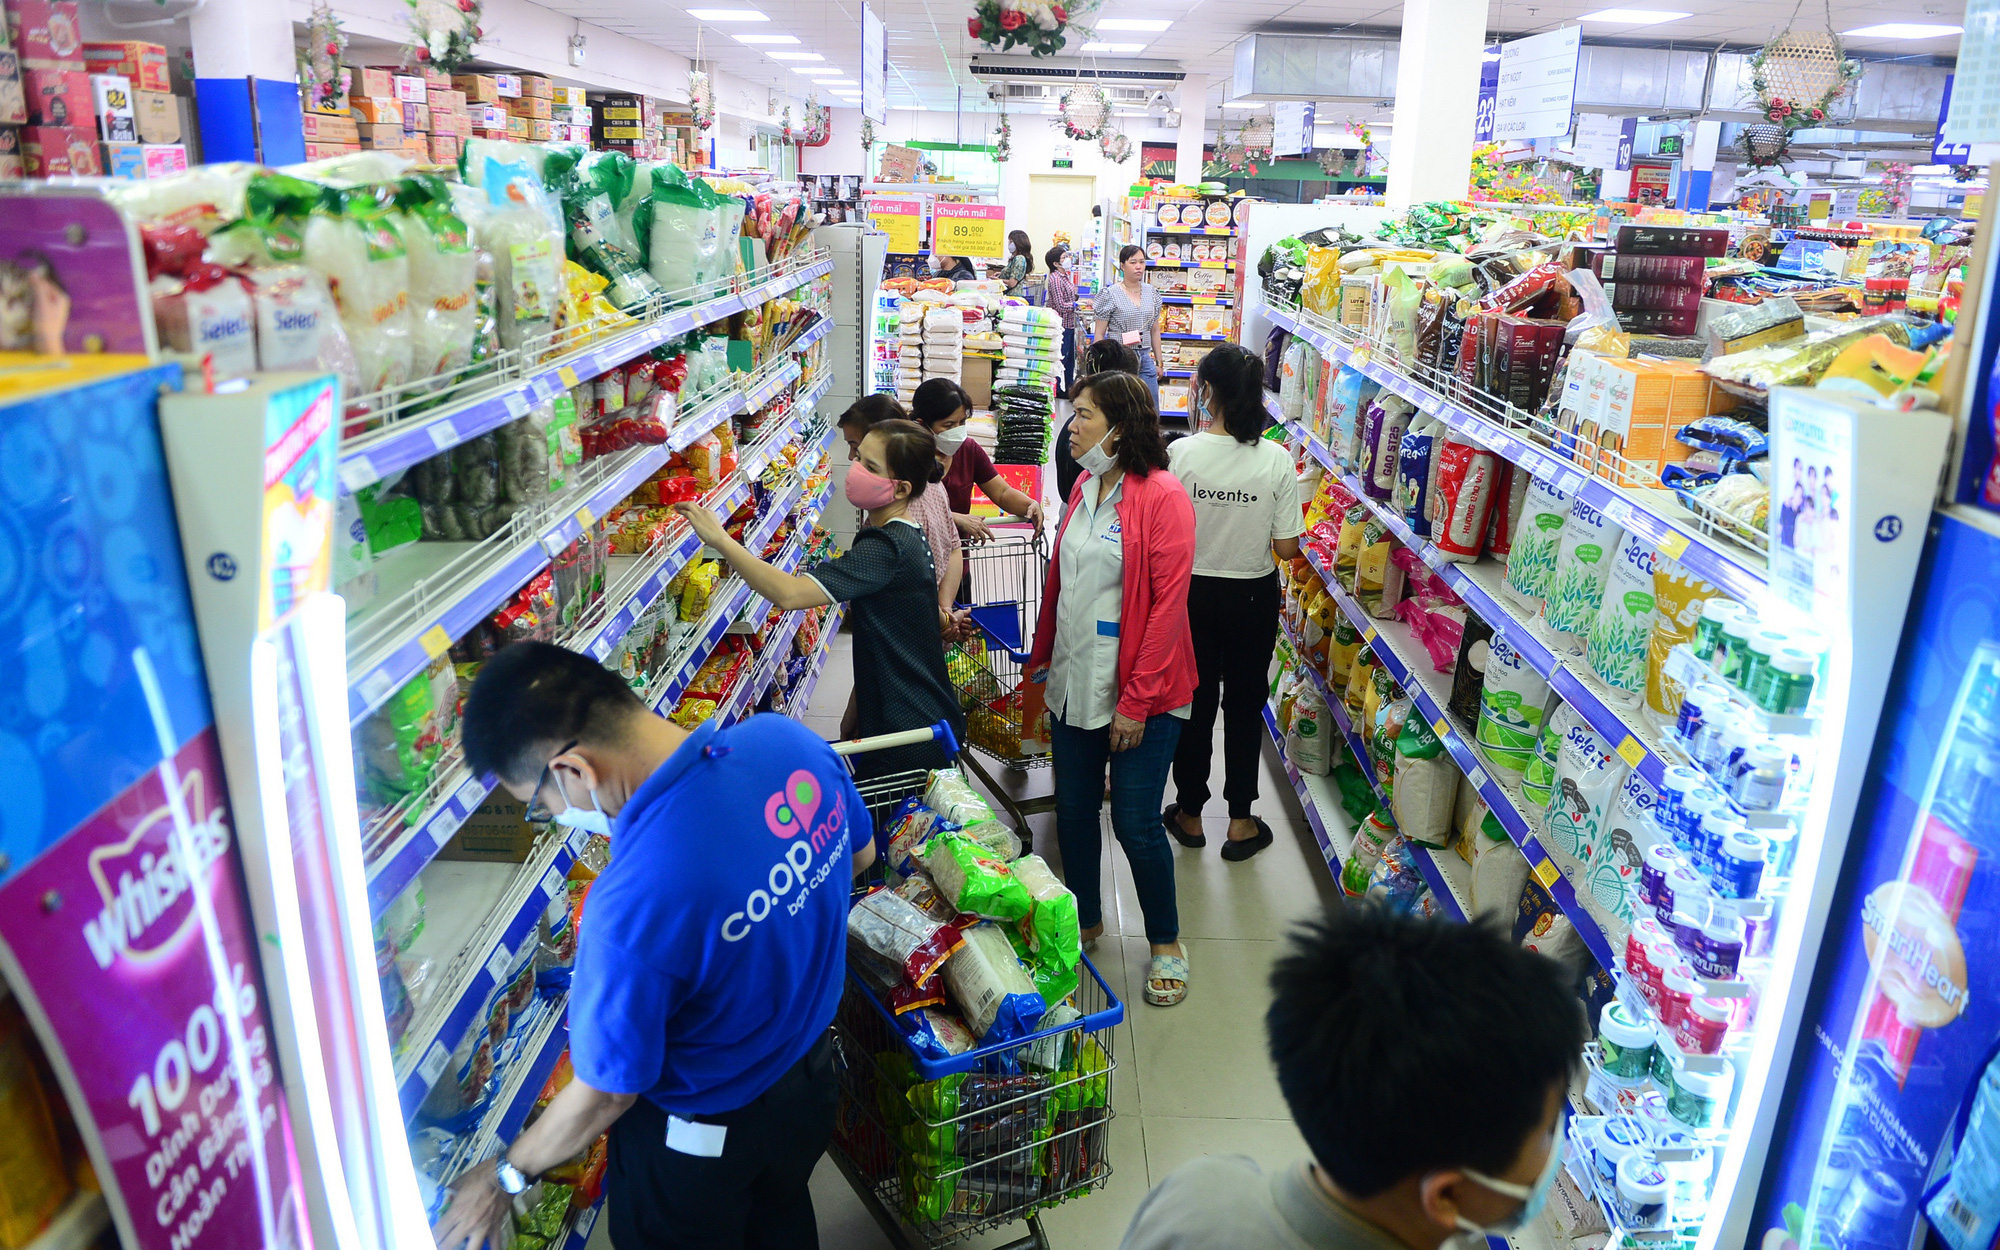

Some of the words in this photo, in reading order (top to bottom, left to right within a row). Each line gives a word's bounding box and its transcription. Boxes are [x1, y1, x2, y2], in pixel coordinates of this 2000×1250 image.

[1477, 96, 1495, 134] 23
[1302, 126, 1312, 148] 20
[1619, 143, 1631, 165] 19
[887, 204, 902, 213] mãi
[936, 206, 969, 218] Khuyến
[970, 208, 987, 218] mãi
[1194, 270, 1212, 280] Coffee
[1387, 426, 1400, 452] ST25
[1877, 518, 1900, 538] 43
[721, 840, 813, 942] co.op
[787, 886, 810, 917] bạn
[809, 862, 831, 890] của
[1861, 894, 1970, 1016] SmartHeart
